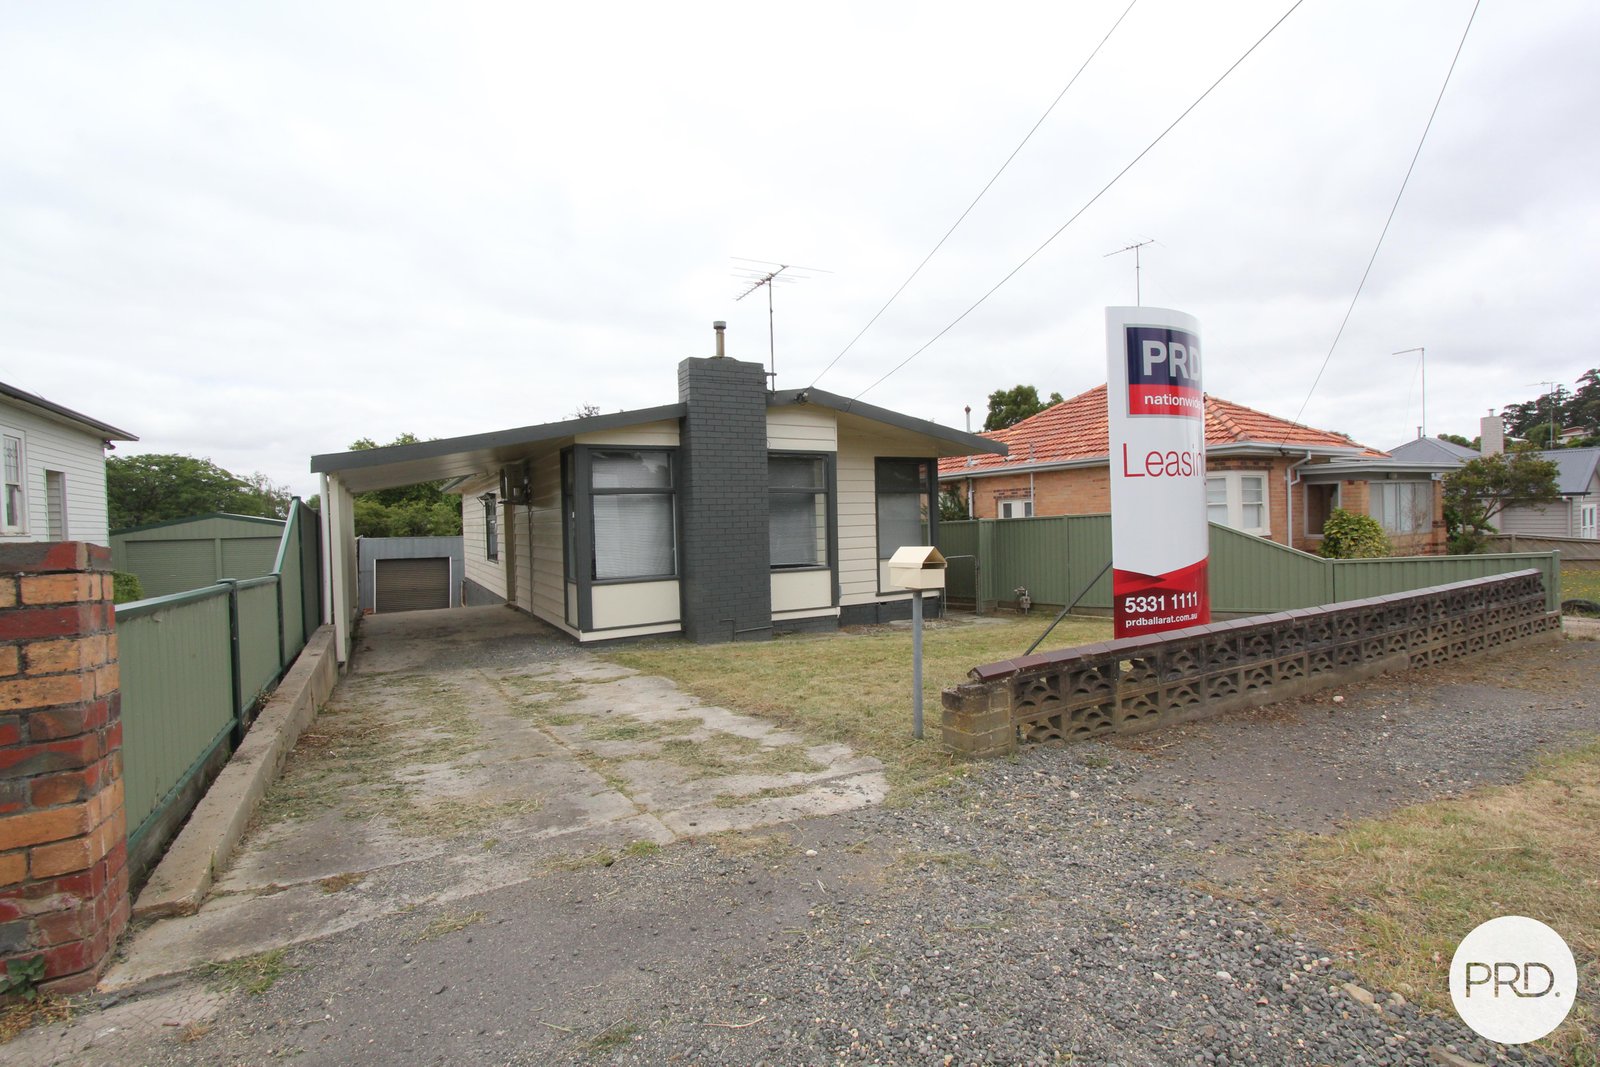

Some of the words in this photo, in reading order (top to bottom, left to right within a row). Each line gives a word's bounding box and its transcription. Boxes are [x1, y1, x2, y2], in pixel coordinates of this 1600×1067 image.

[1142, 340, 1201, 381] PRD
[1122, 442, 1206, 479] Leasin
[1124, 595, 1165, 613] 5331
[1171, 591, 1198, 610] 1111
[1125, 612, 1198, 628] prdballarat.com.au
